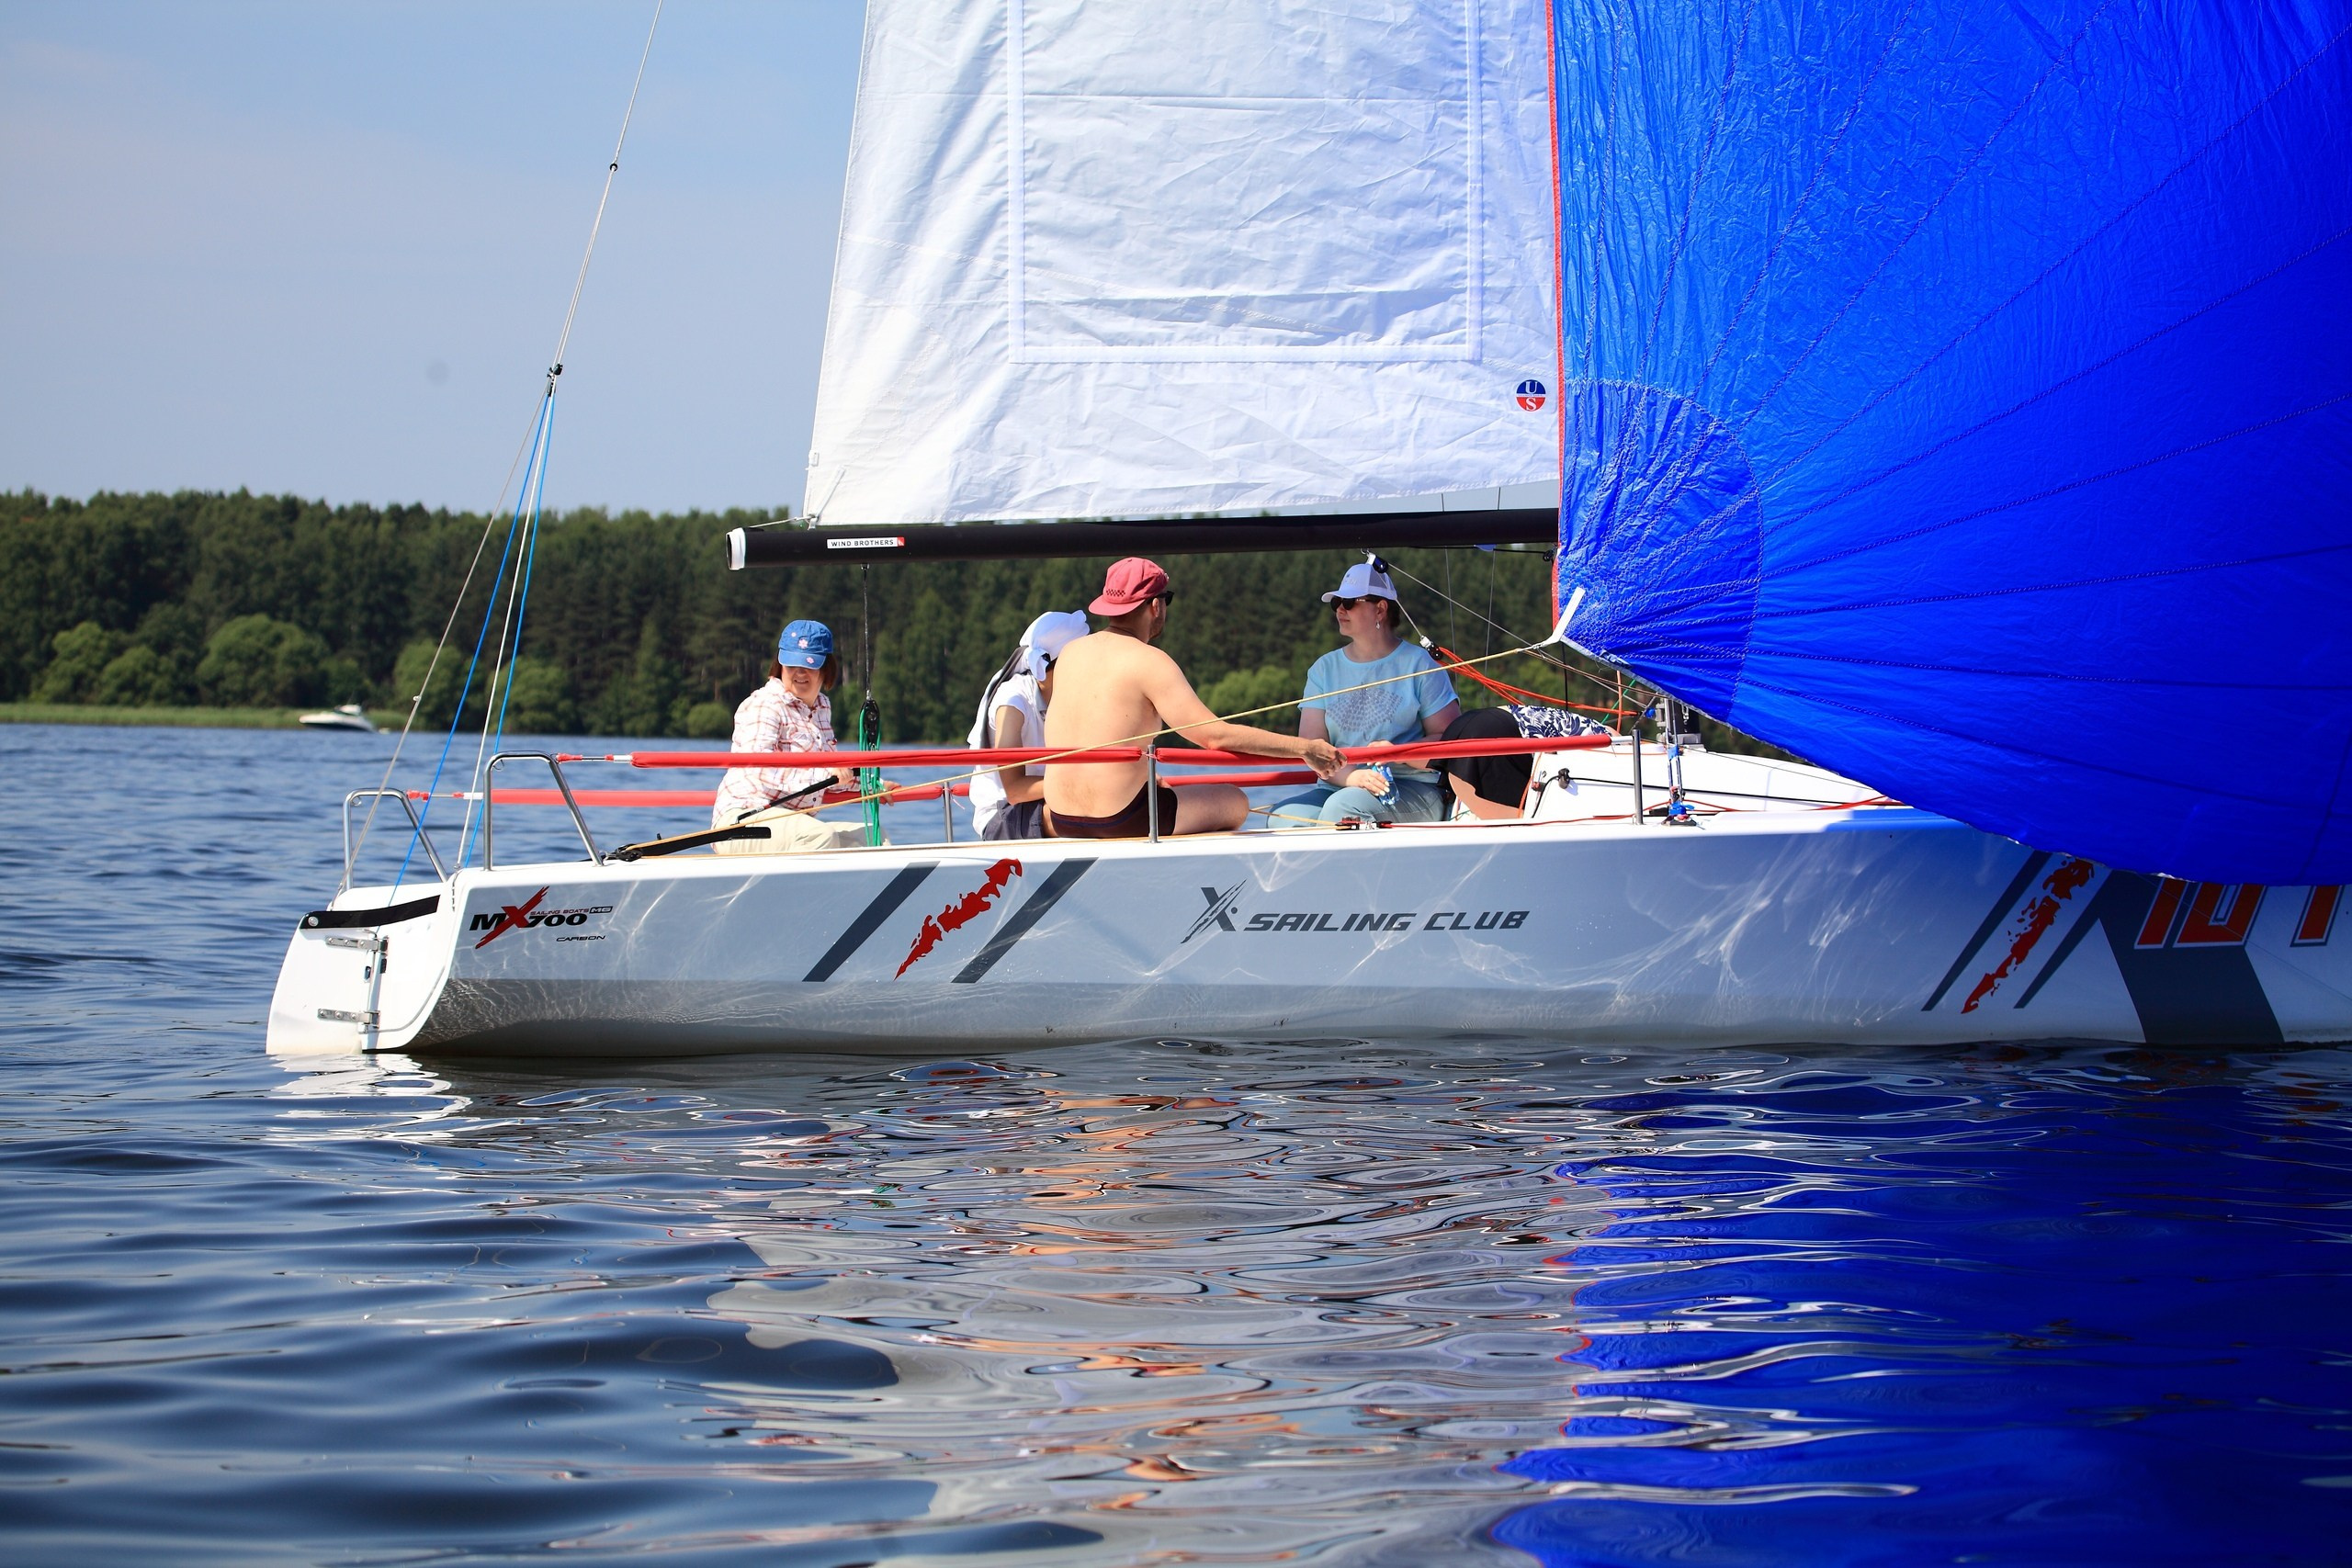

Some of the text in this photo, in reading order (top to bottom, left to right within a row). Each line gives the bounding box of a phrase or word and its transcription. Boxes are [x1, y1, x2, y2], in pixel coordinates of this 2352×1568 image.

[1525, 381, 1538, 394] U
[1525, 397, 1537, 411] S
[1244, 913, 1417, 932] SAILING
[1423, 910, 1531, 931] CLUB
